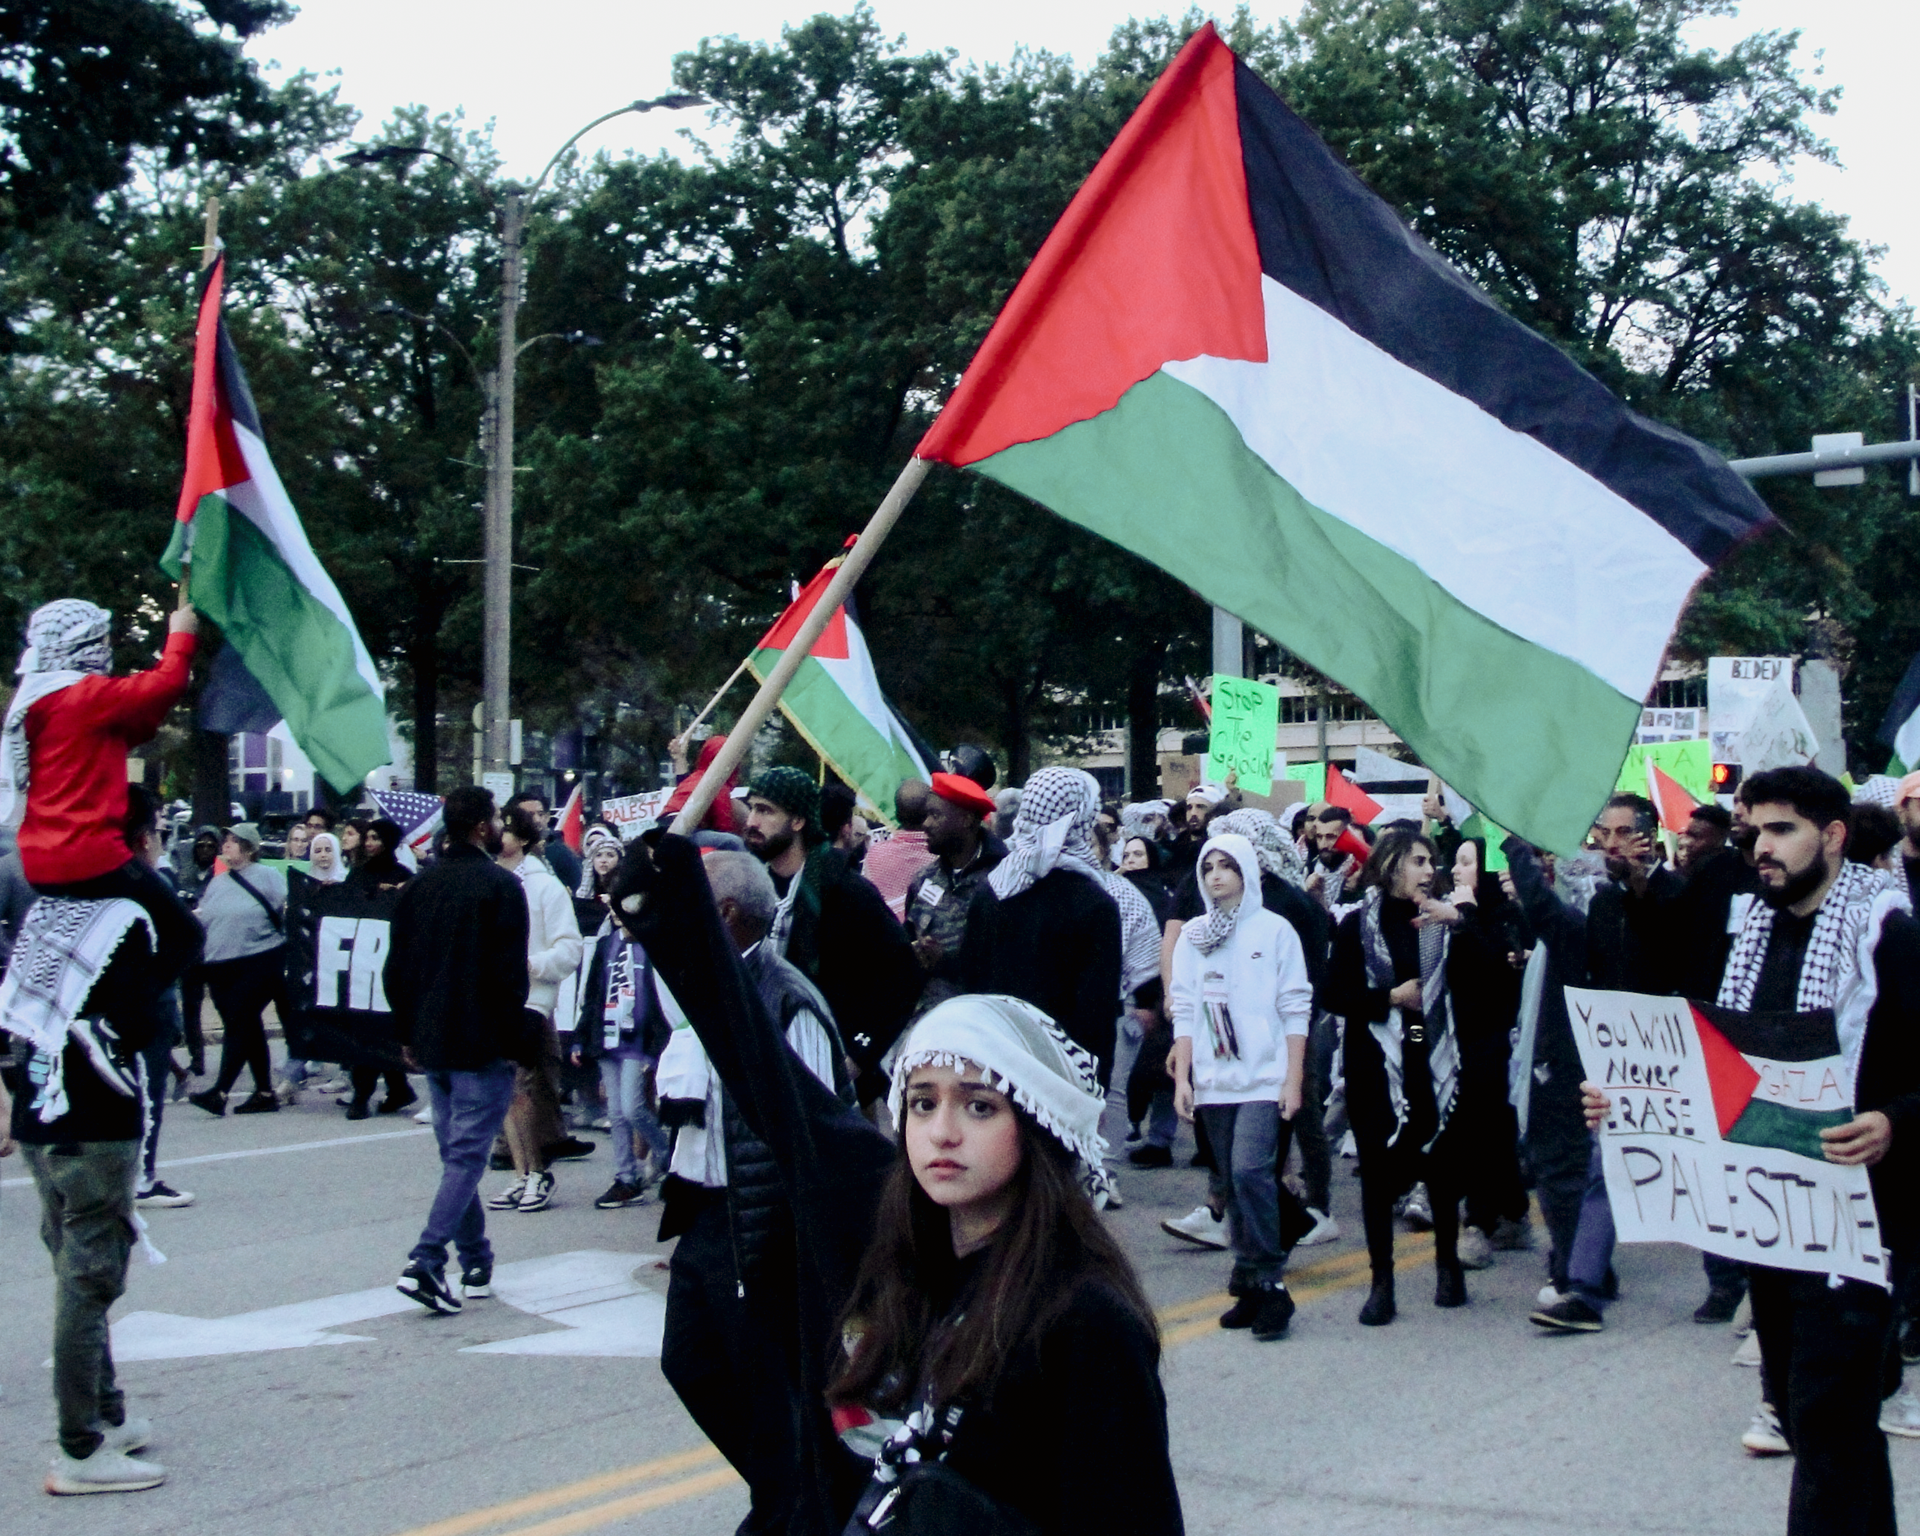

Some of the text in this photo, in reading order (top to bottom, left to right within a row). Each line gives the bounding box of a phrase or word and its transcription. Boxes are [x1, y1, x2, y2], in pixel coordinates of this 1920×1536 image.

[1731, 660, 1782, 681] BIDEN
[1673, 748, 1695, 768] A
[1575, 1000, 1686, 1059] You Will
[1606, 1057, 1679, 1088] Never
[1762, 1064, 1844, 1102] GAZA
[1607, 1096, 1695, 1136] RASE
[1621, 1146, 1881, 1265] PALESTINE
